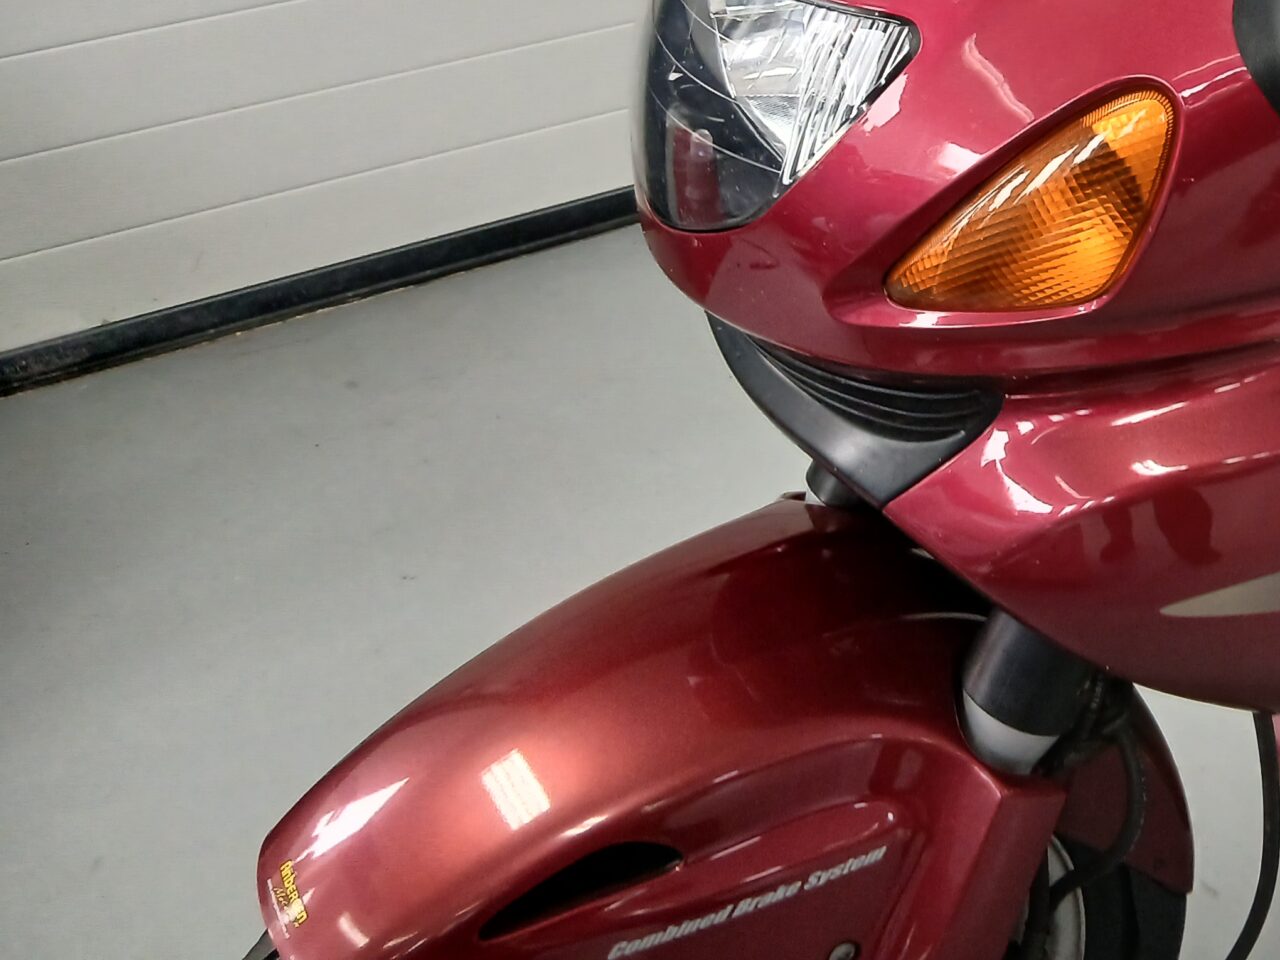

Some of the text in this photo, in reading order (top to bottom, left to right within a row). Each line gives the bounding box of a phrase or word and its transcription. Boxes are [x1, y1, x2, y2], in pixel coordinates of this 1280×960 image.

[607, 845, 887, 960] Combined Brake System
